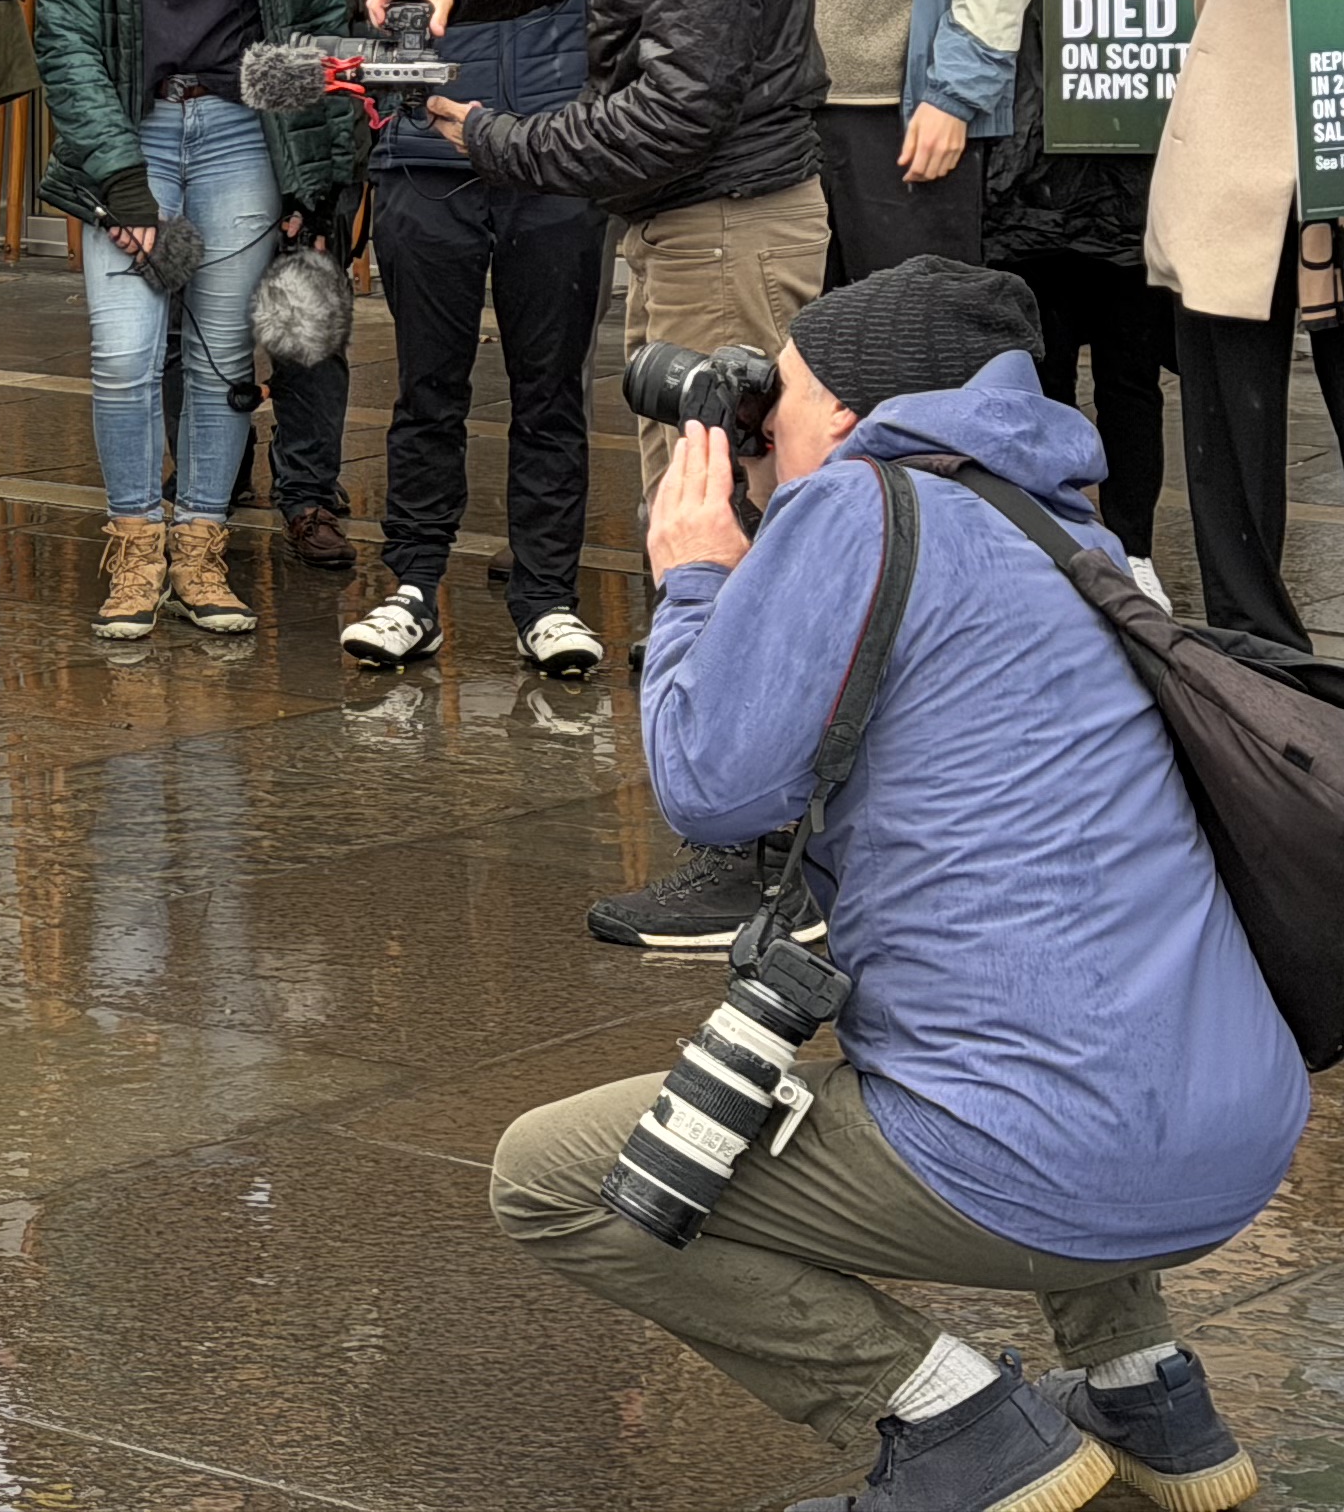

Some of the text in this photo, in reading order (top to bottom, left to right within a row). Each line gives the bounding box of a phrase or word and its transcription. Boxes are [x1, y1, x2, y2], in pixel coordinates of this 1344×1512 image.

[1061, 43, 1098, 70] ON
[1062, 73, 1149, 99] FARMS
[1311, 75, 1330, 96] IN
[1313, 98, 1337, 120] ON
[1315, 155, 1338, 171] Sea
